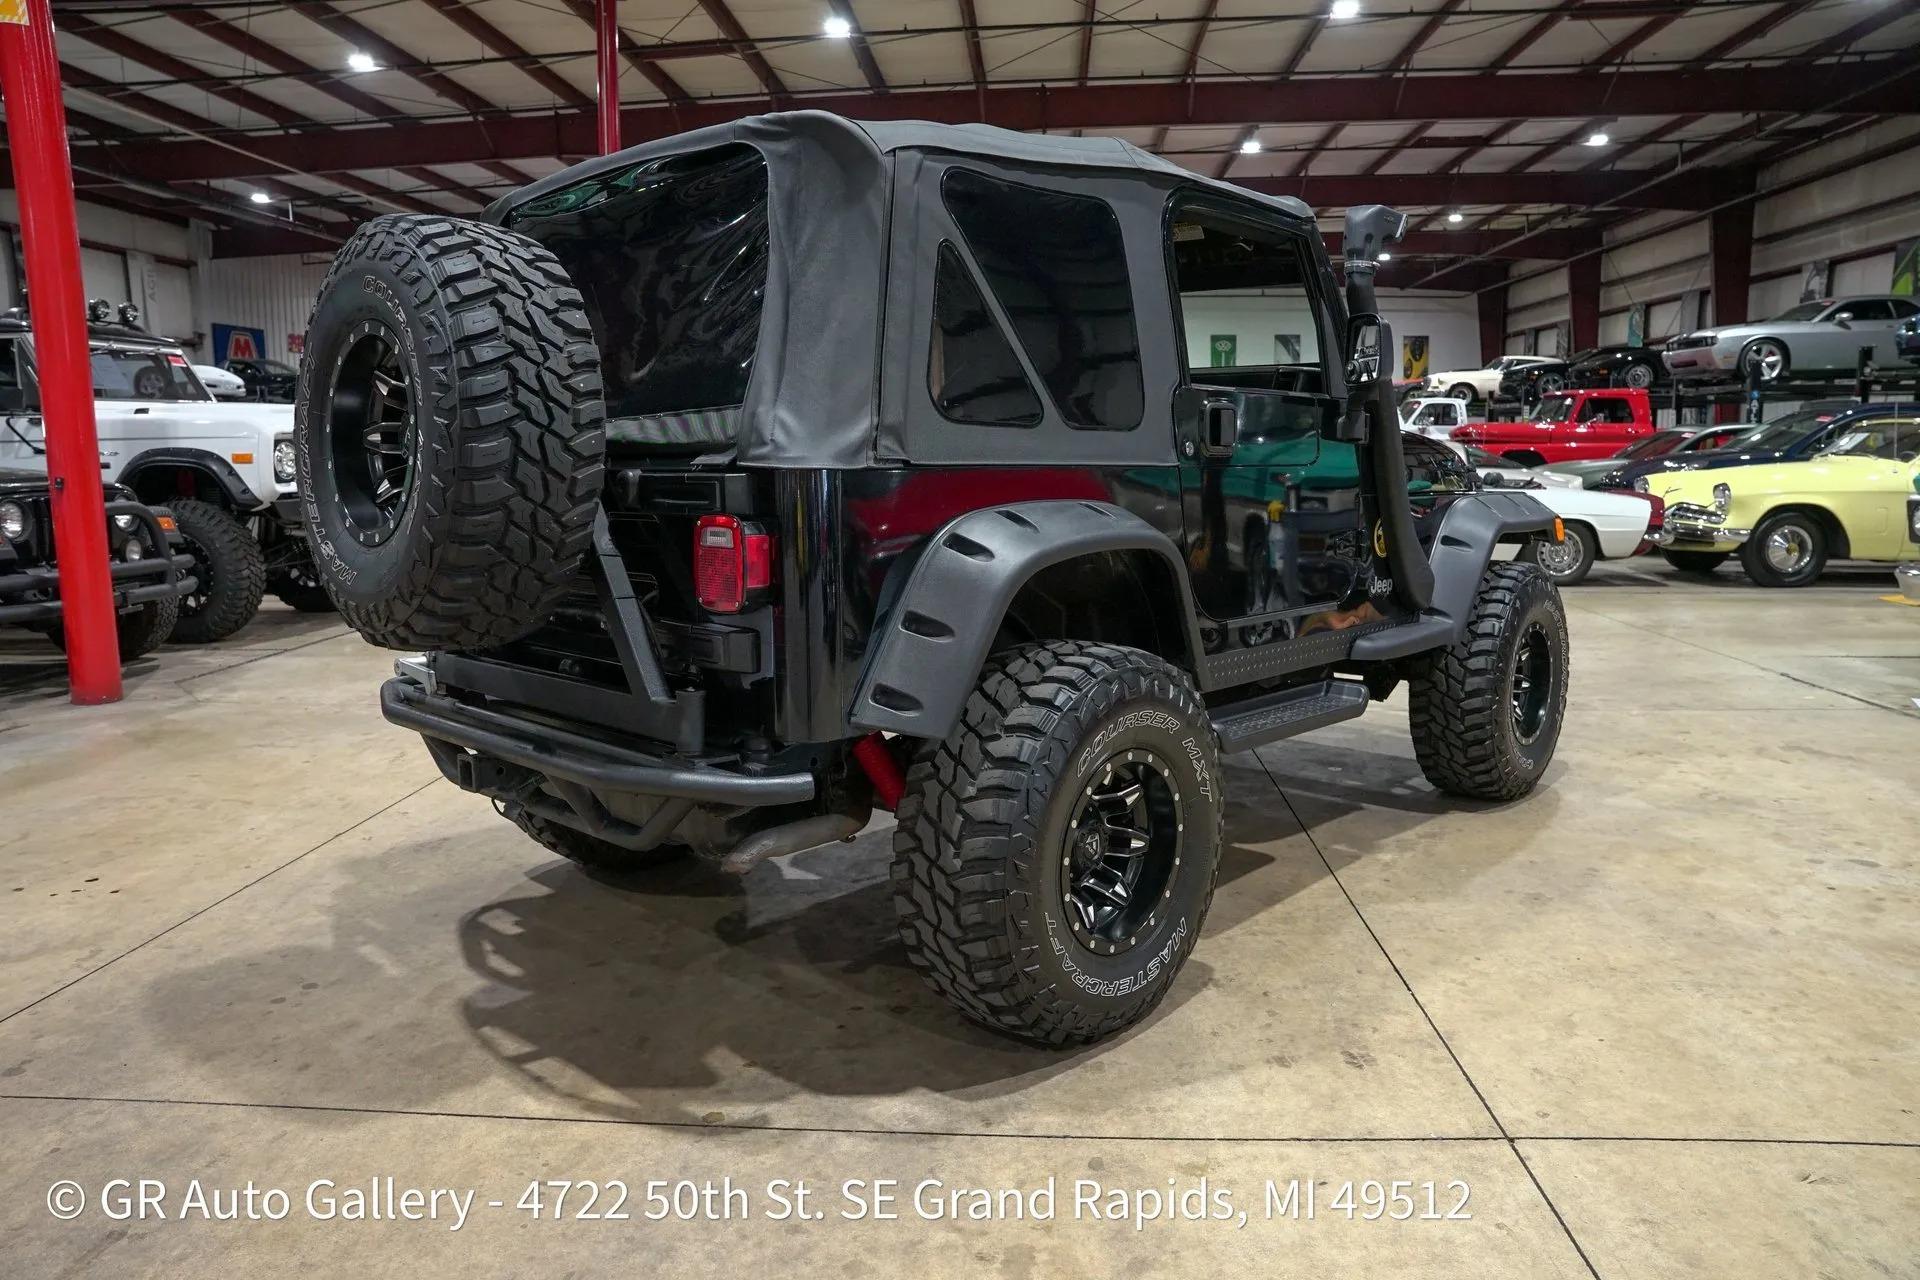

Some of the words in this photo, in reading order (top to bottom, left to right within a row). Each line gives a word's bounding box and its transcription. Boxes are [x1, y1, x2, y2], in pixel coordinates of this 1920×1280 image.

[299, 342, 357, 586] MASTERCRAFT
[1370, 576, 1393, 595] Jeep
[1077, 710, 1181, 778] COURSER
[1181, 737, 1213, 803] MXT
[1044, 911, 1188, 997] MASTERCRAFT
